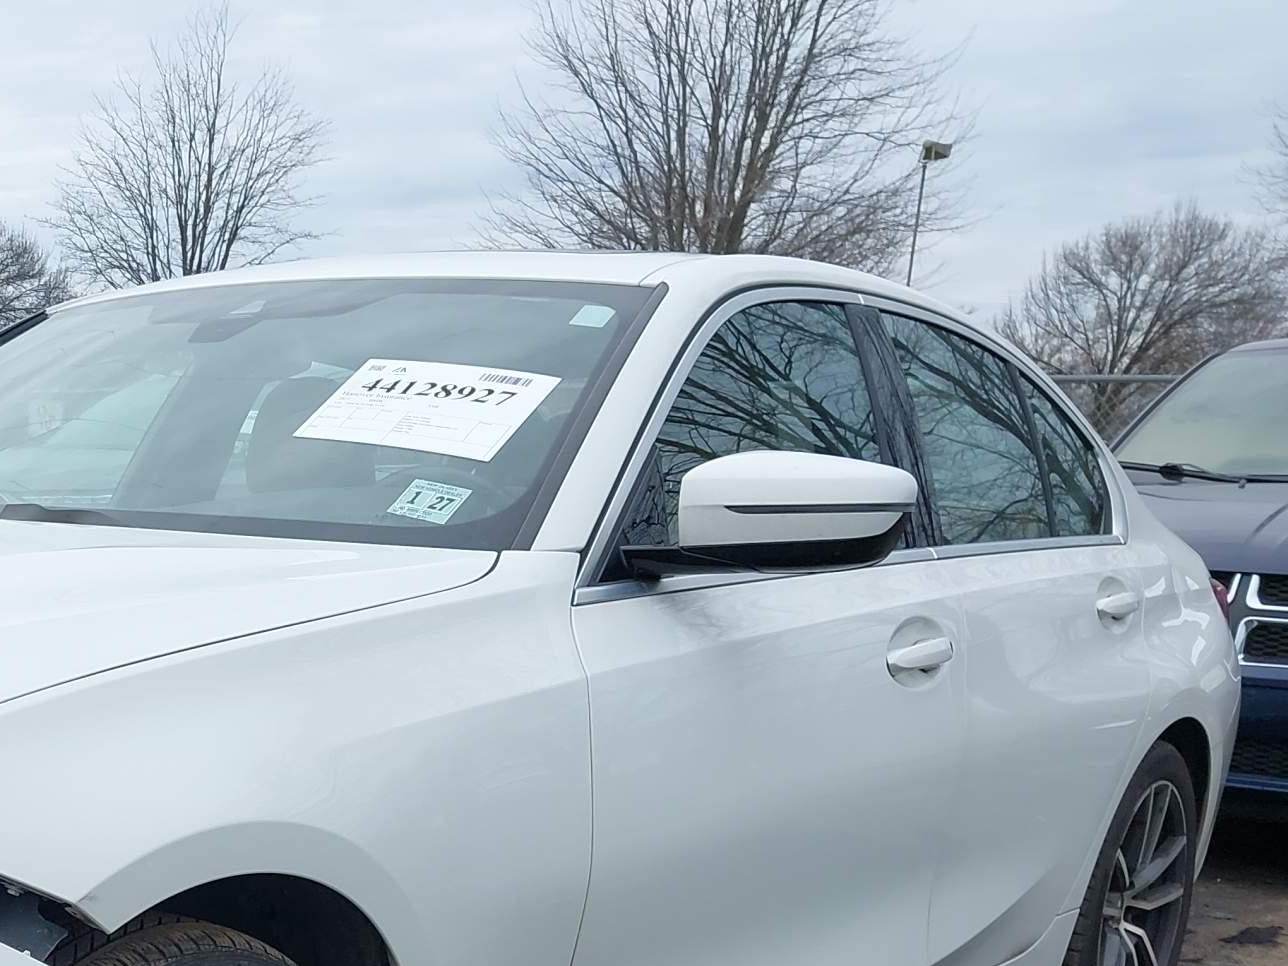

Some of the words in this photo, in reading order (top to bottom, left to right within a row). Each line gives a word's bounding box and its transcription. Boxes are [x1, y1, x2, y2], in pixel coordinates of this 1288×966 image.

[361, 378, 518, 406] 44128927
[406, 491, 422, 505] 1
[427, 495, 456, 511] 27
